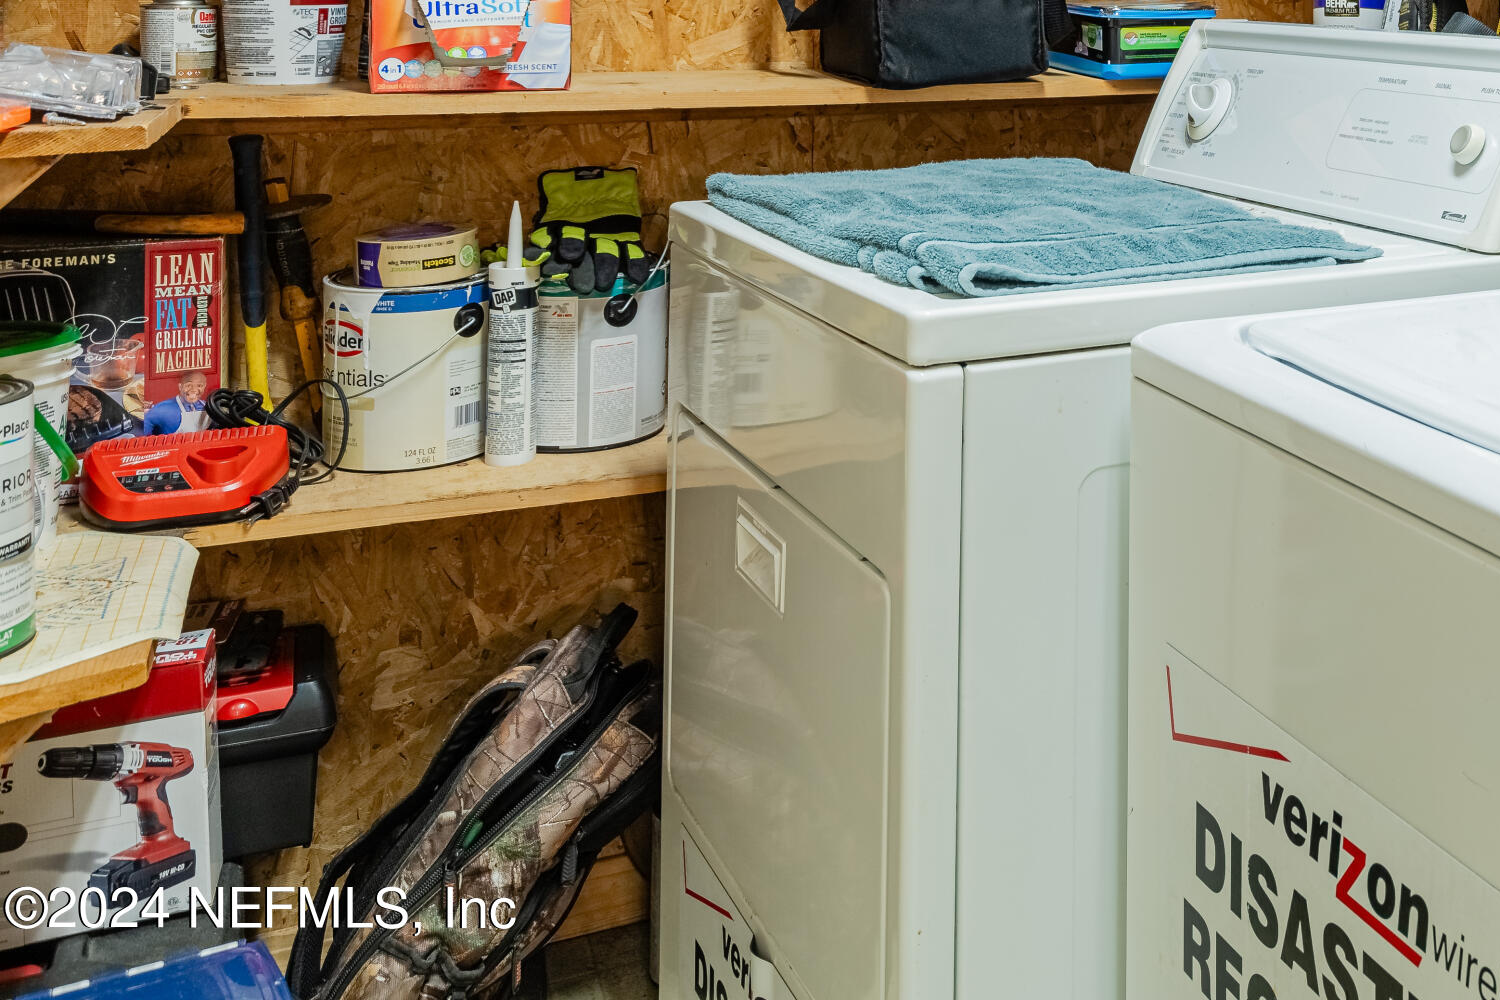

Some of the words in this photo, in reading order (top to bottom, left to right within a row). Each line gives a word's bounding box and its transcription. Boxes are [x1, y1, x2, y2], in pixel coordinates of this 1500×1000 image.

[330, 8, 347, 16] VINYL
[530, 63, 558, 71] SCENT
[1378, 77, 1408, 85] TEMPERATURE
[22, 254, 117, 269] FOREMAN'S
[423, 257, 454, 268] Scotch
[155, 252, 215, 287] LEAN
[155, 284, 213, 298] MEAN
[494, 291, 515, 306] DAP
[155, 297, 192, 331] FAT
[196, 295, 208, 327] REDUCING
[155, 328, 212, 350] GRILLING
[155, 347, 212, 373] MACHINE
[120, 451, 171, 464] Milwaukee
[416, 457, 431, 465] 3.66
[159, 869, 170, 879] 18V
[1262, 771, 1429, 968] verizon
[1195, 801, 1420, 1000] DISAST
[1183, 897, 1278, 1000] RE
